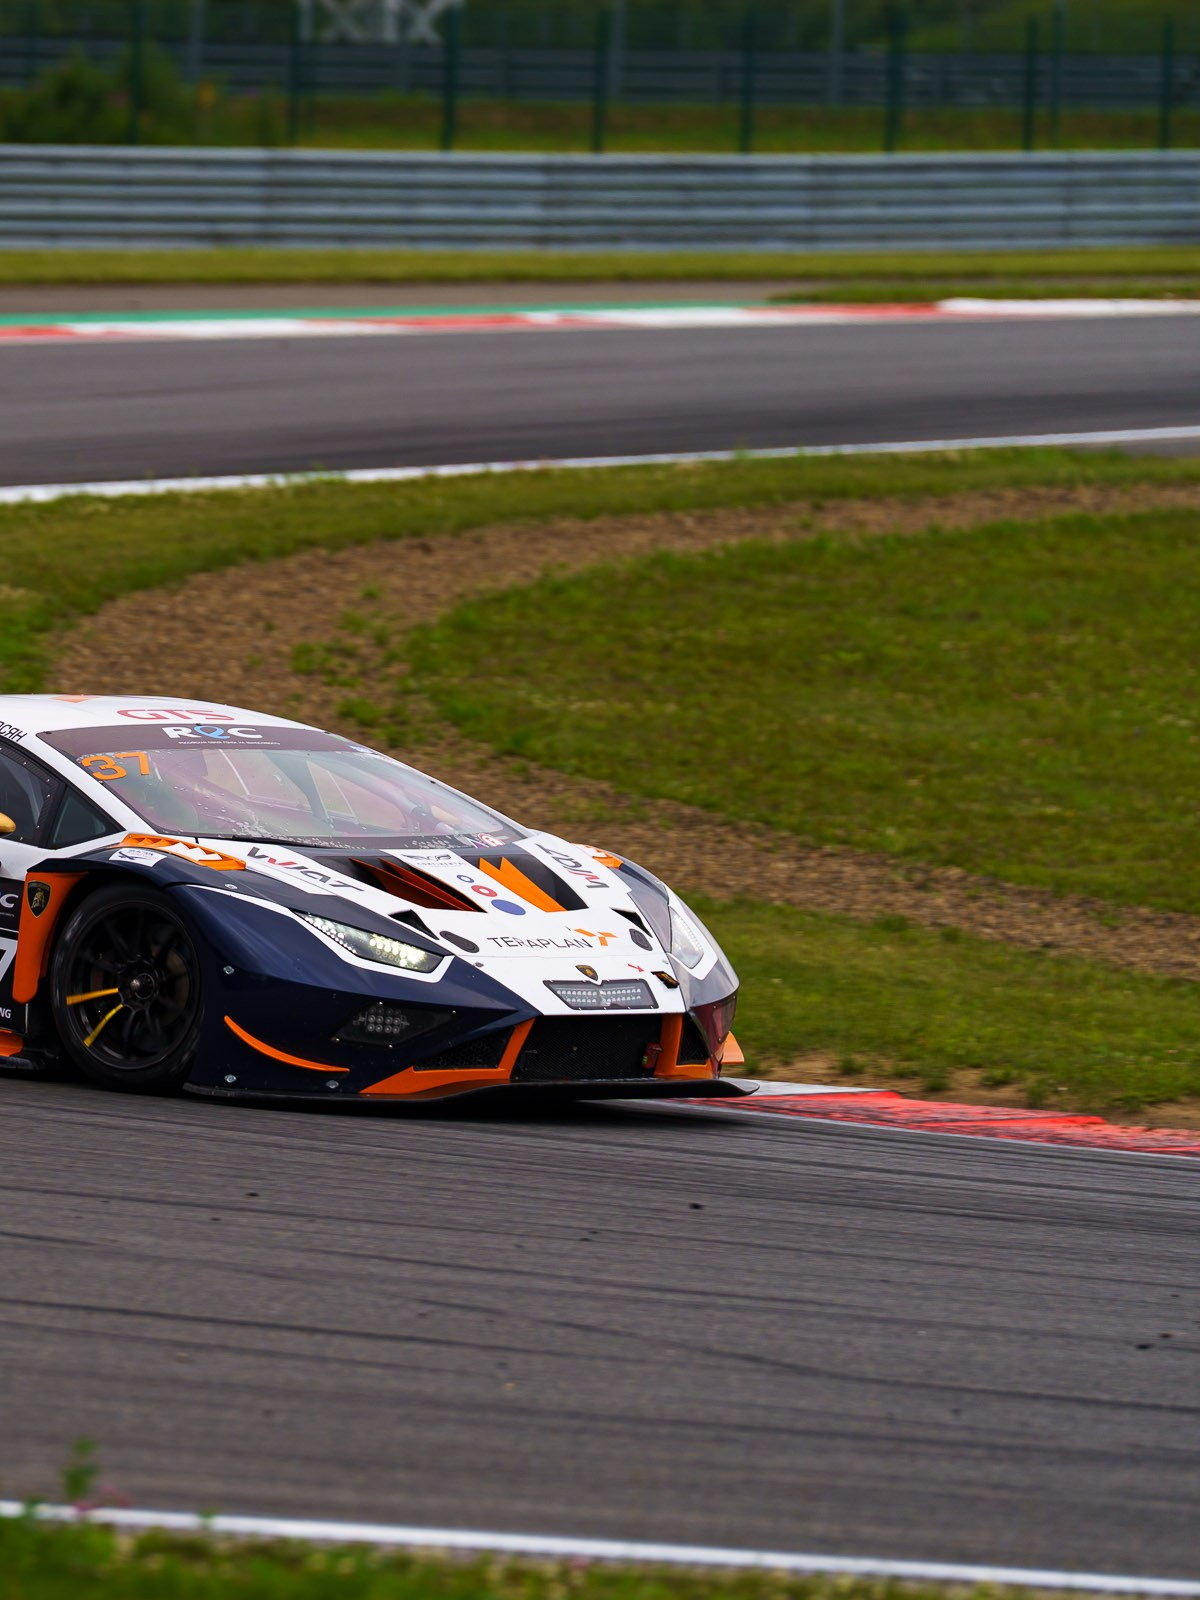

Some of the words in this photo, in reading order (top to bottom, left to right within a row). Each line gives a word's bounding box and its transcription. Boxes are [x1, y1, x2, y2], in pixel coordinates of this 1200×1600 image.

[117, 709, 235, 721] GTS
[81, 751, 151, 781] 37
[487, 936, 593, 948] TERAPLAN
